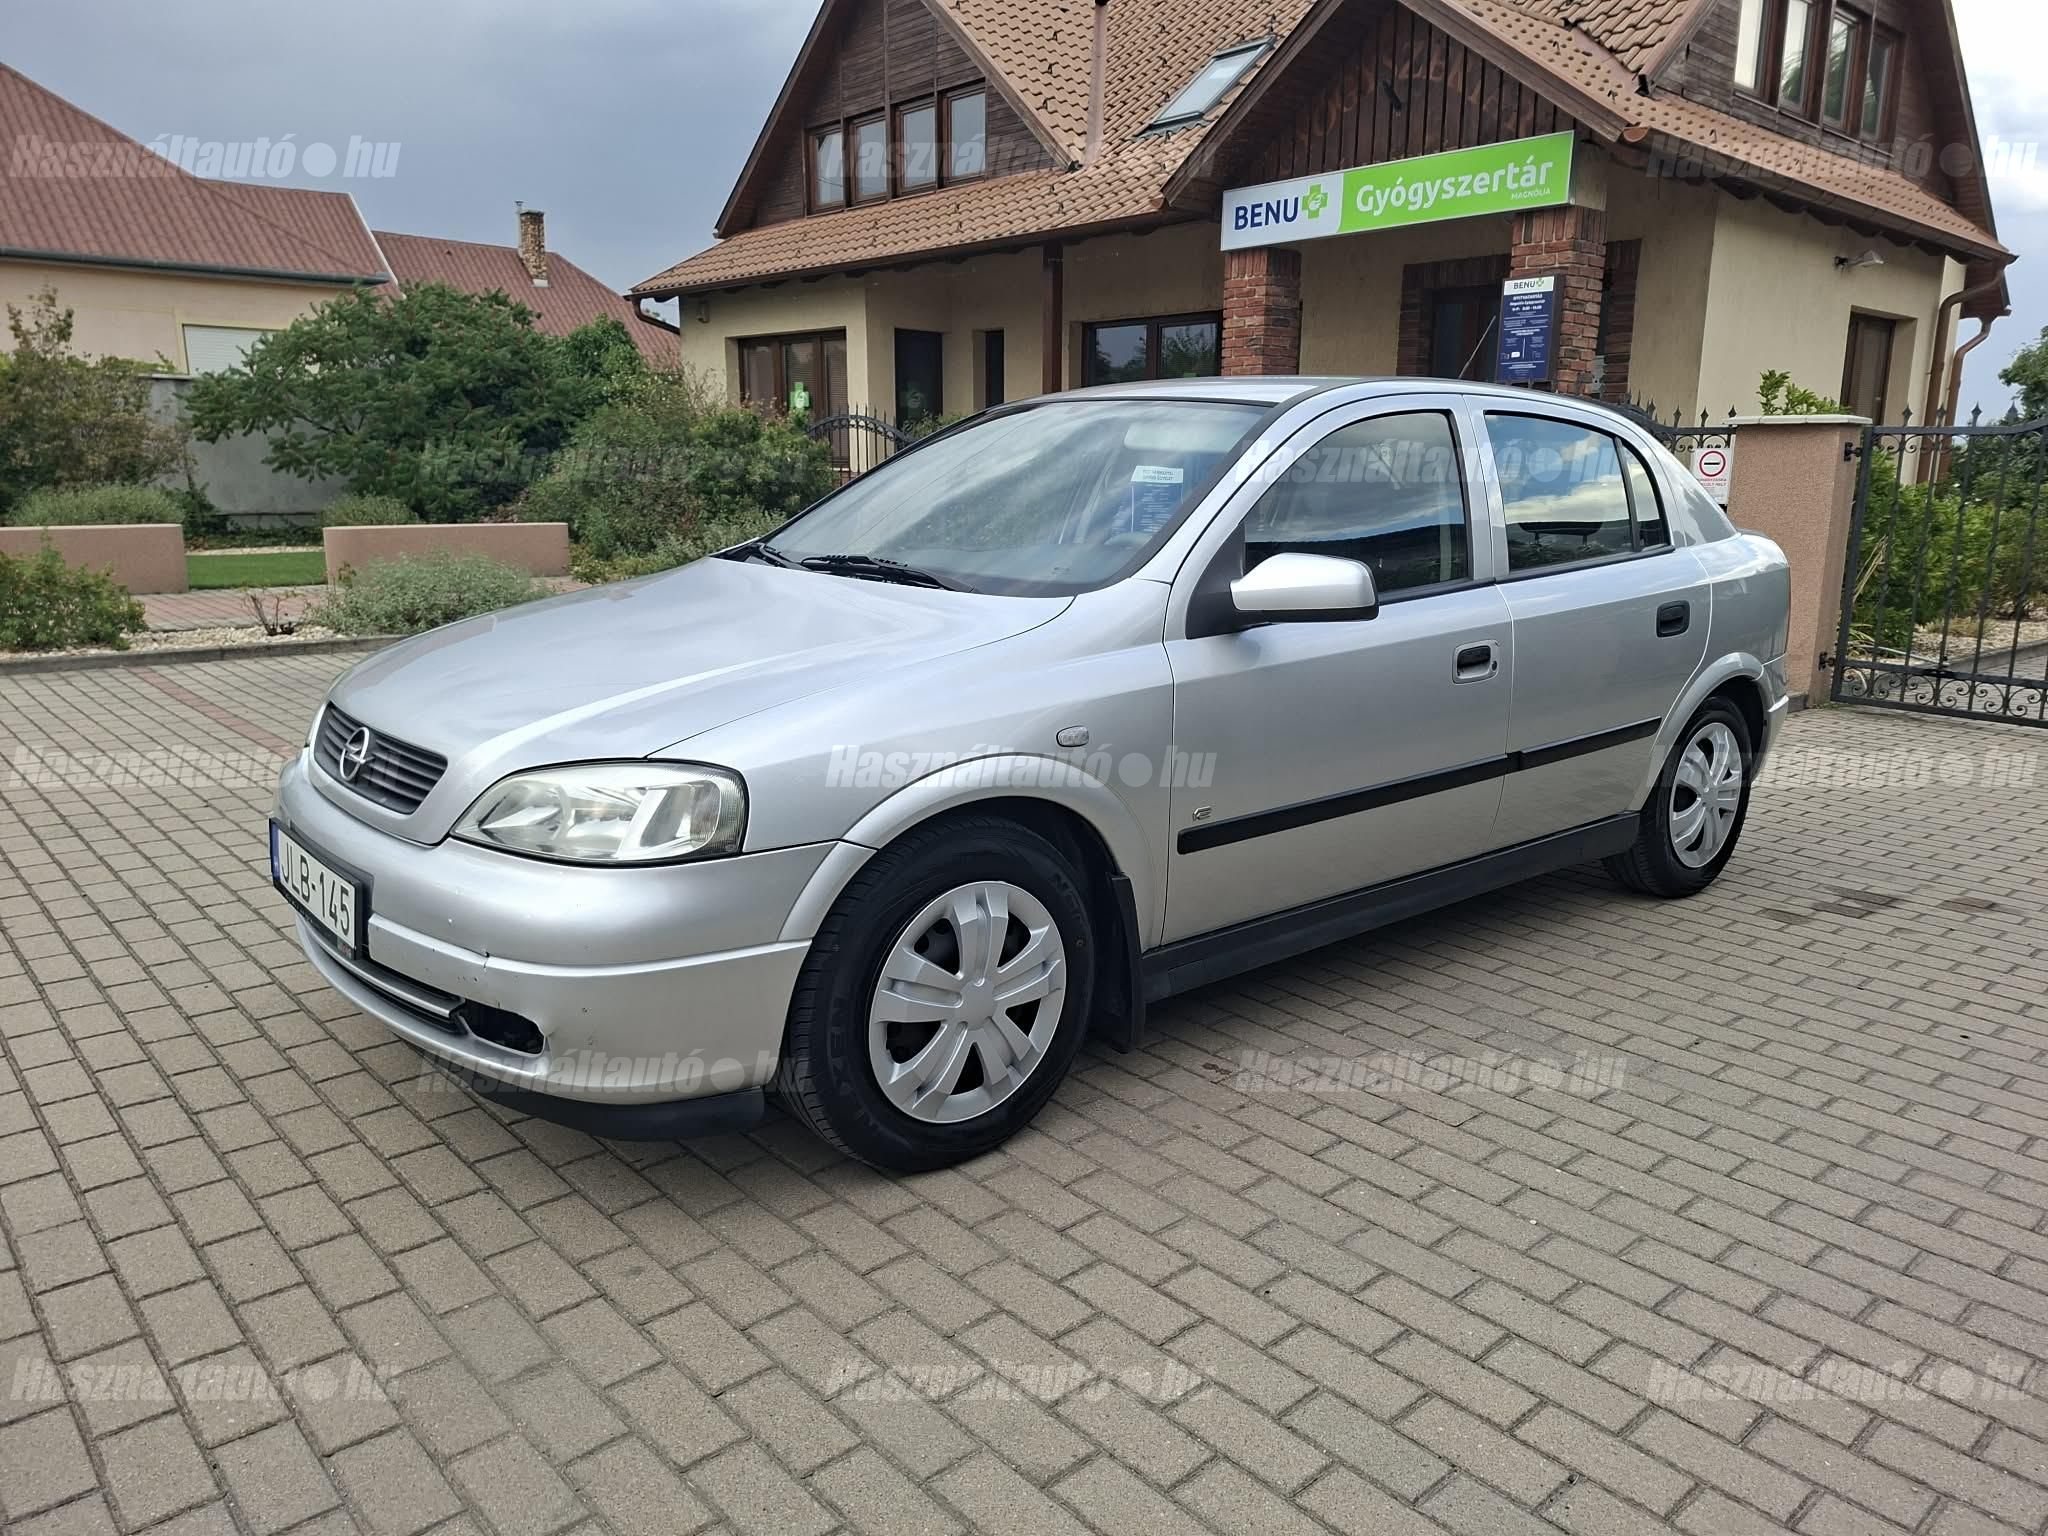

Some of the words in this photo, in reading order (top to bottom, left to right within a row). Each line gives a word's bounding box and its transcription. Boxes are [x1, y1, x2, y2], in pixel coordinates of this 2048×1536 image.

[1234, 198, 1298, 230] BENU
[1356, 155, 1553, 216] Gyógyszertár
[1513, 281, 1536, 290] BENU
[282, 842, 350, 936] JLB-145
